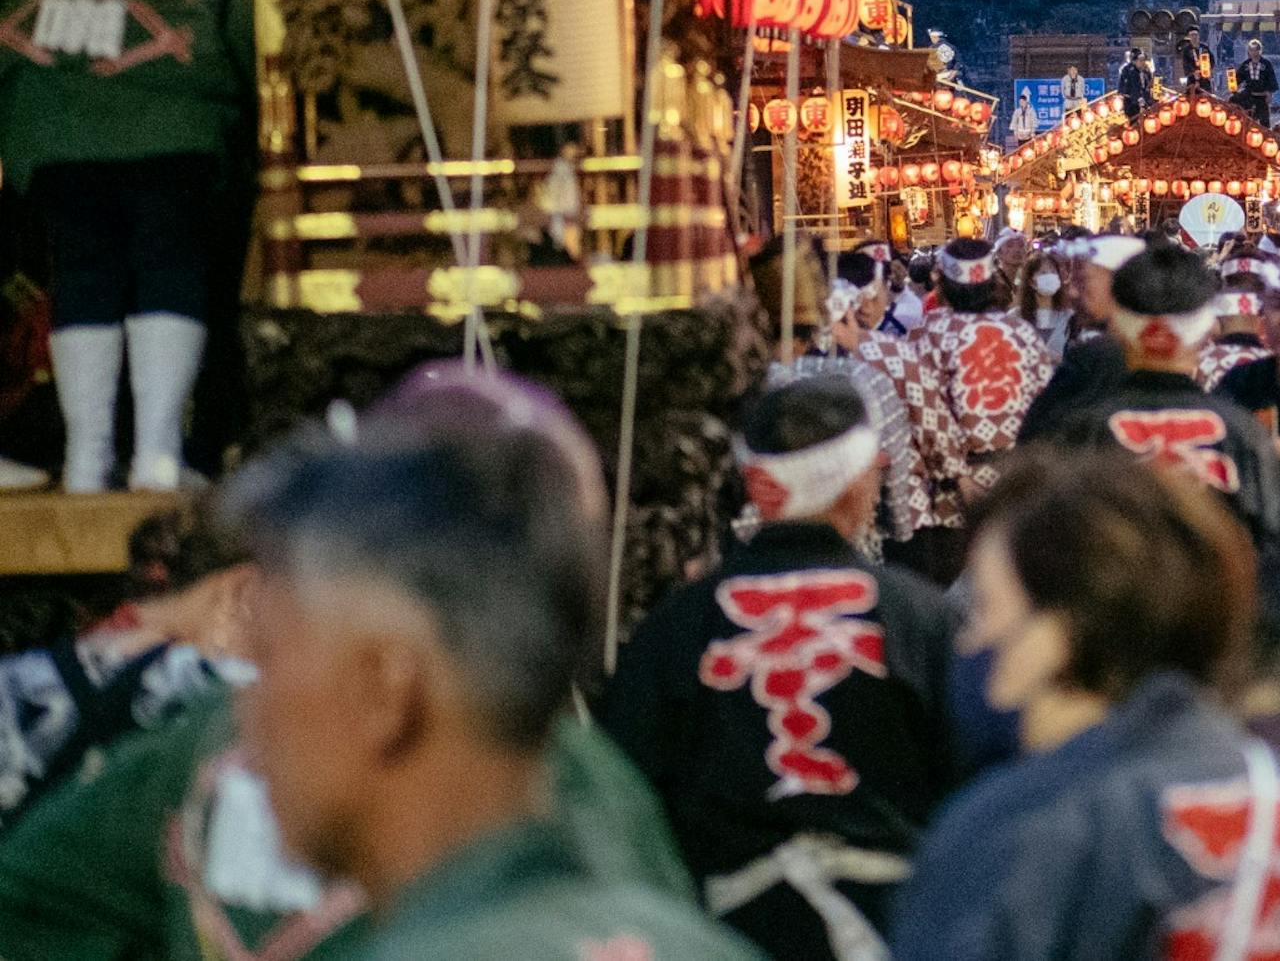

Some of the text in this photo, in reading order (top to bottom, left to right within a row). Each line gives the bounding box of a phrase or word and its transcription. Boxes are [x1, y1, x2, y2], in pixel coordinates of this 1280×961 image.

[864, 0, 889, 24] 東
[768, 104, 792, 131] 東
[806, 103, 830, 130] 東
